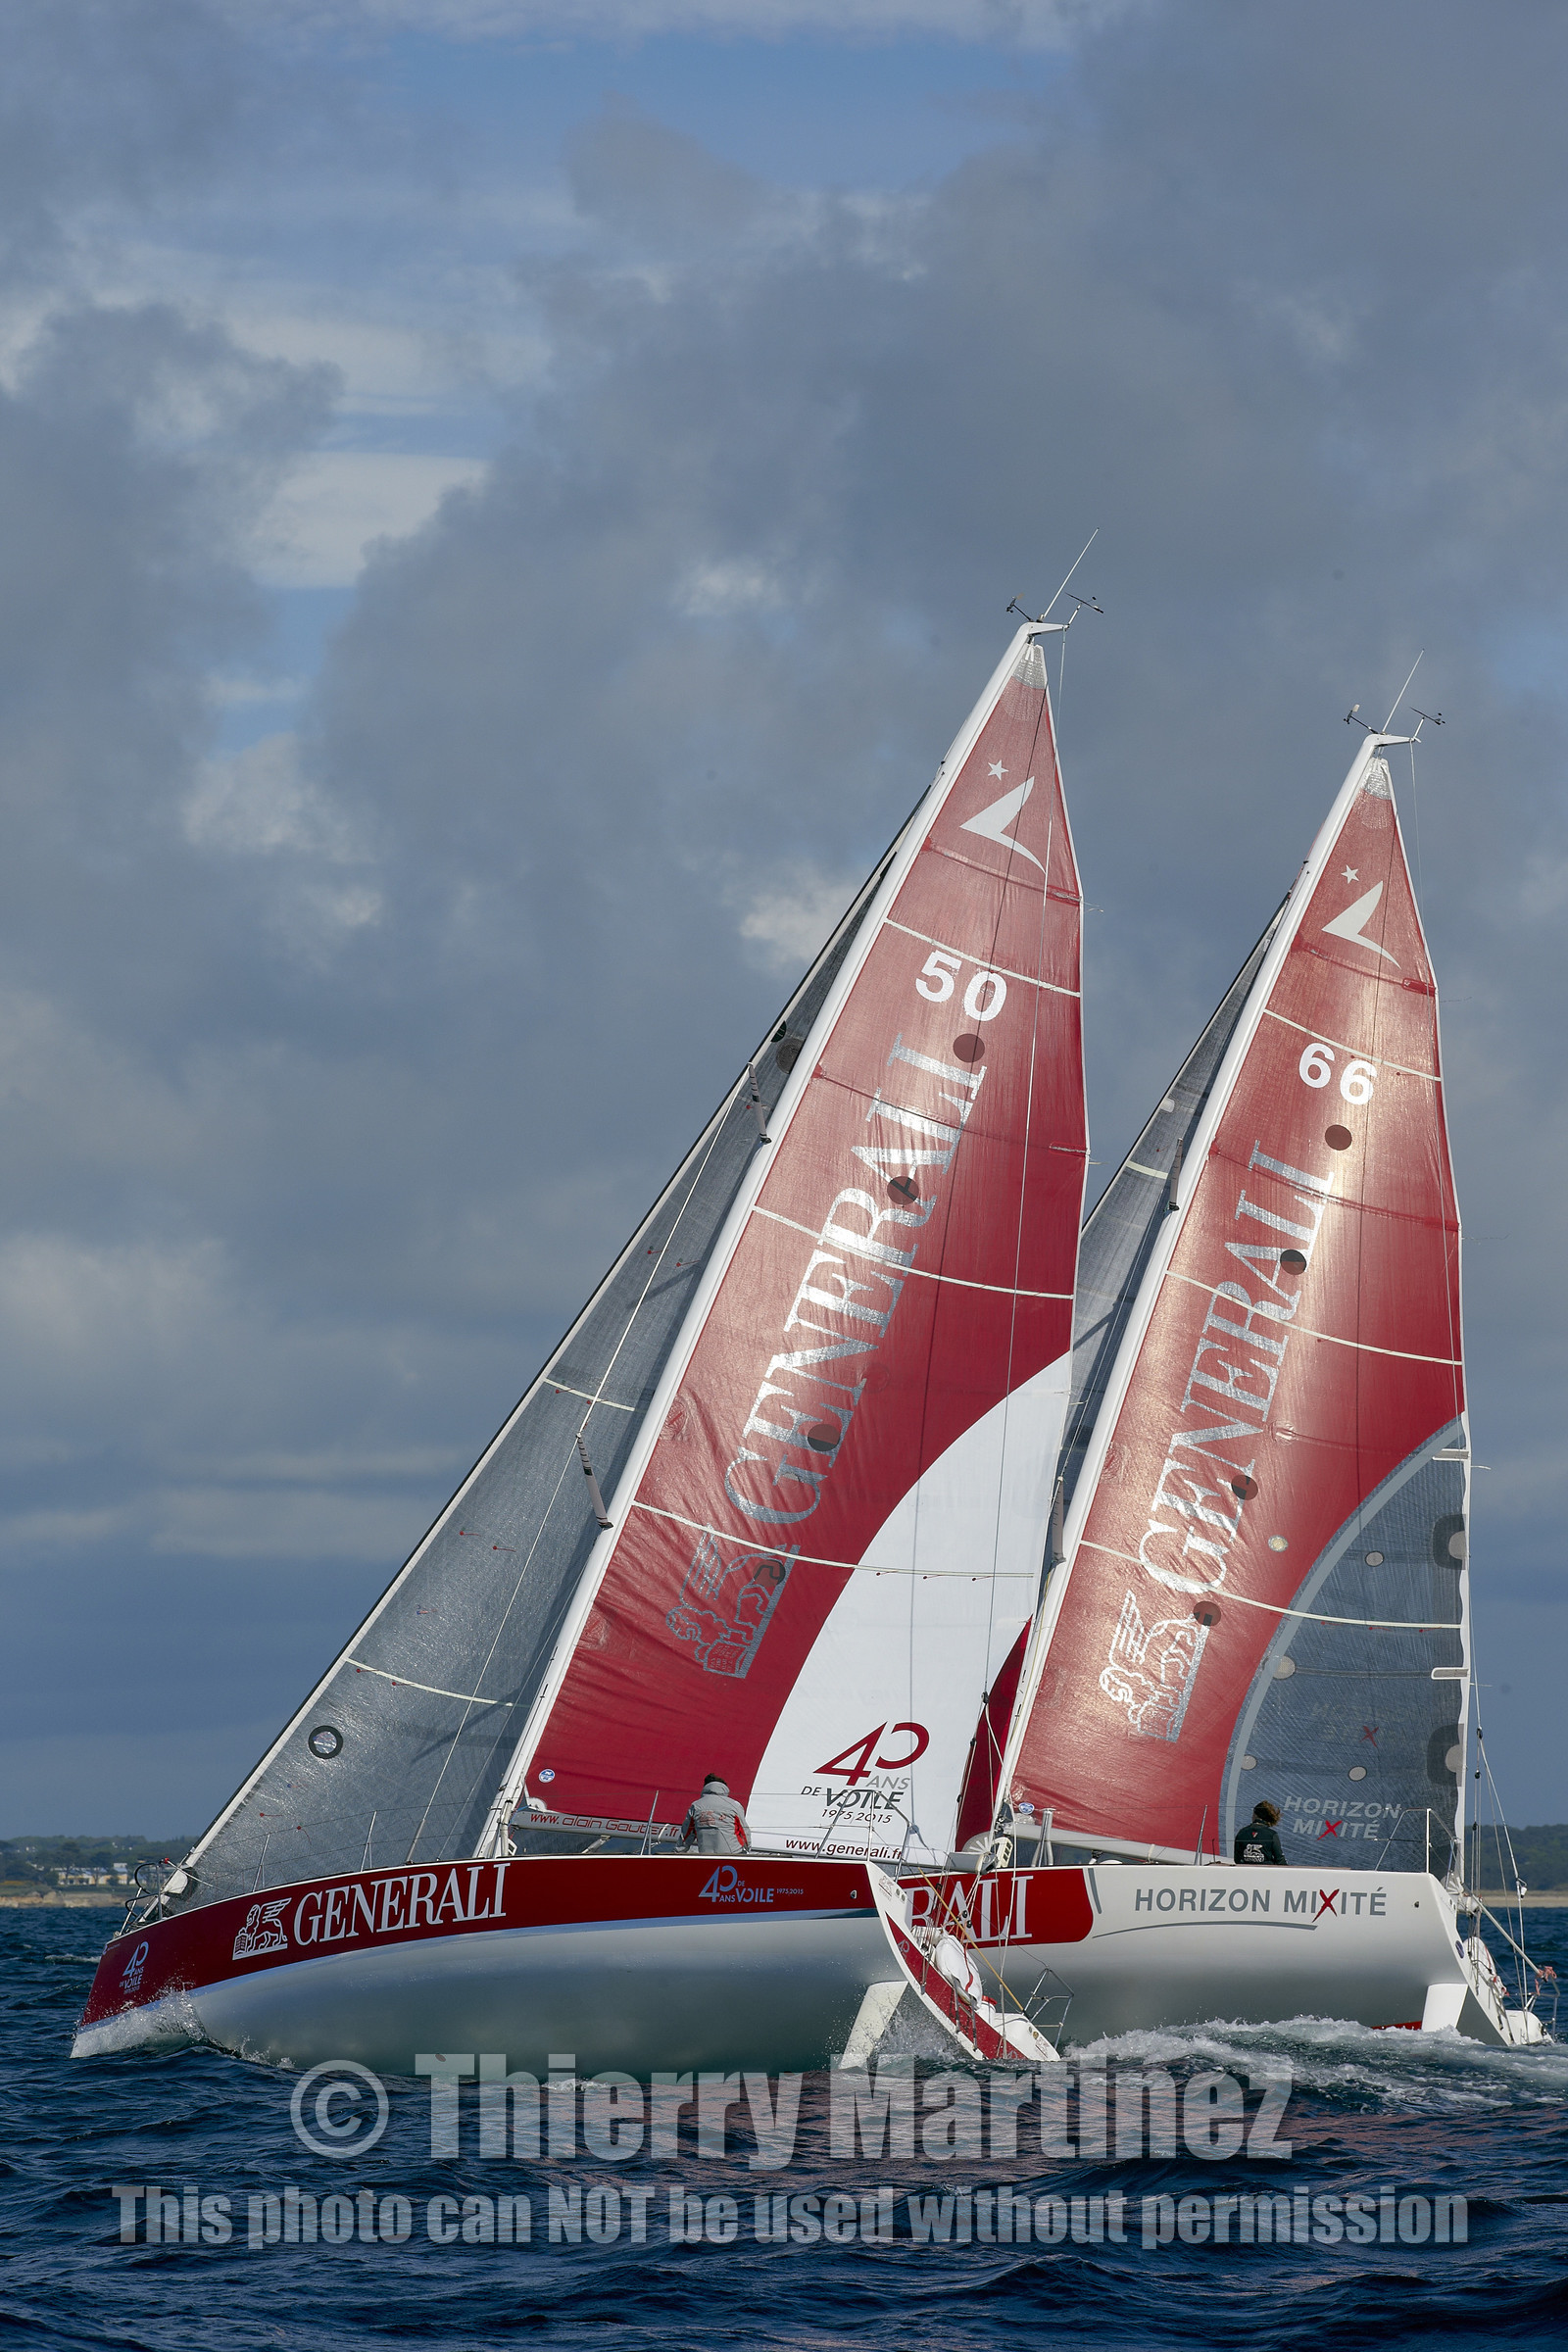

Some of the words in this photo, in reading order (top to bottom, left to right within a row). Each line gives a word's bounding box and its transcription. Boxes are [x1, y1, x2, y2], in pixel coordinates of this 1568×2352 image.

[915, 950, 1007, 1022] 50
[1298, 1042, 1378, 1105] 66
[724, 1031, 988, 1525] GENERALI
[1139, 1139, 1332, 1595] GENERALI
[865, 1775, 911, 1790] ANS
[801, 1786, 821, 1796] DE
[826, 1788, 905, 1810] VOILE
[1283, 1795, 1402, 1819] HORIZON
[605, 1819, 680, 1838] Gauter.fr
[1292, 1819, 1381, 1842] MIXITÉ
[785, 1838, 903, 1860] www.generali.fr
[294, 1862, 511, 1946] GENERALI
[718, 1894, 736, 1903] ANS
[735, 1887, 775, 1903] VOILE
[1135, 1887, 1271, 1912] HORIZON
[1283, 1886, 1388, 1923] MIXITÉ
